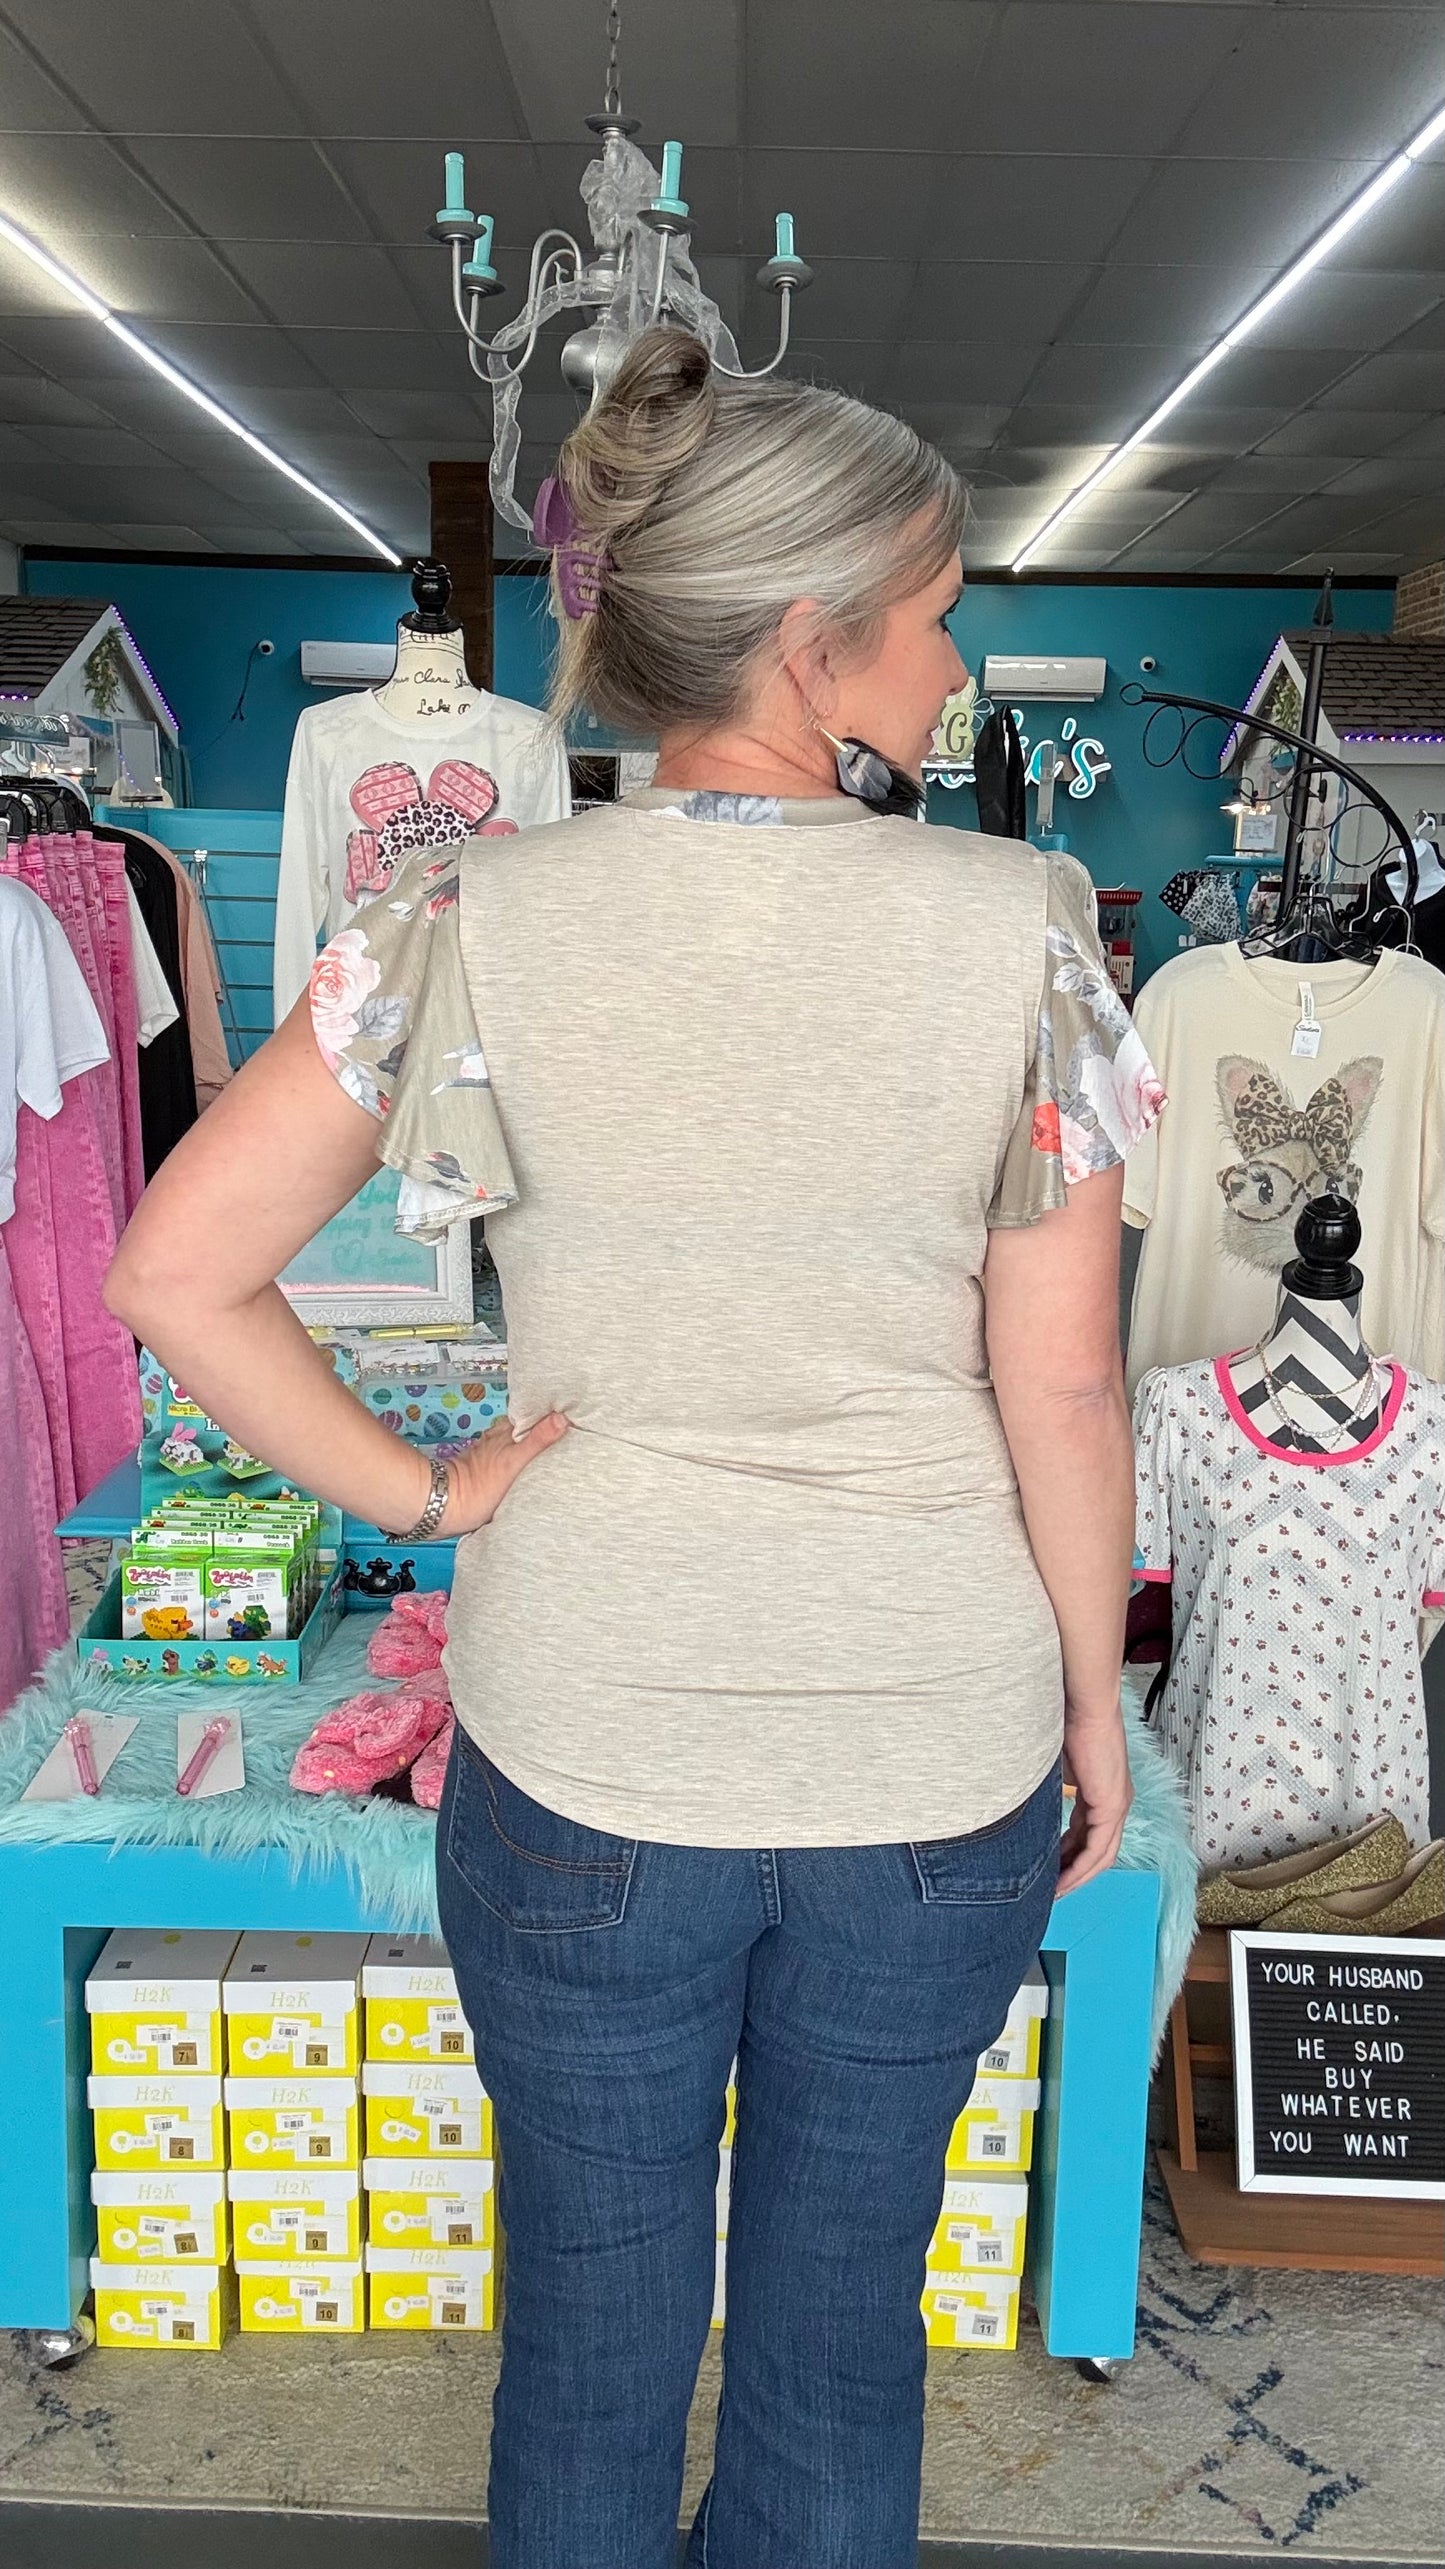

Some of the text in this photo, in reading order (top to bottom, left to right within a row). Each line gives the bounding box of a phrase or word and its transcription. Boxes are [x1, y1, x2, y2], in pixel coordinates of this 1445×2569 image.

[945, 712, 968, 753] G
[1261, 1962, 1424, 1990] YOUR HUSBAND
[446, 2040, 459, 2051] 10
[1297, 2038, 1405, 2064] HE SAID
[314, 2052, 321, 2063] 9
[991, 2056, 1004, 2068] 10
[1325, 2067, 1373, 2090] BUY
[1281, 2093, 1412, 2121] WHATEVER
[444, 2132, 457, 2143] 10
[315, 2143, 323, 2154] 9
[988, 2142, 1002, 2153] 10
[1270, 2131, 1410, 2158] YOU WANT
[177, 2146, 185, 2156] 8
[984, 2250, 997, 2261] 11
[319, 2309, 333, 2320] 10
[449, 2313, 461, 2322] 11
[979, 2323, 992, 2334] 11
